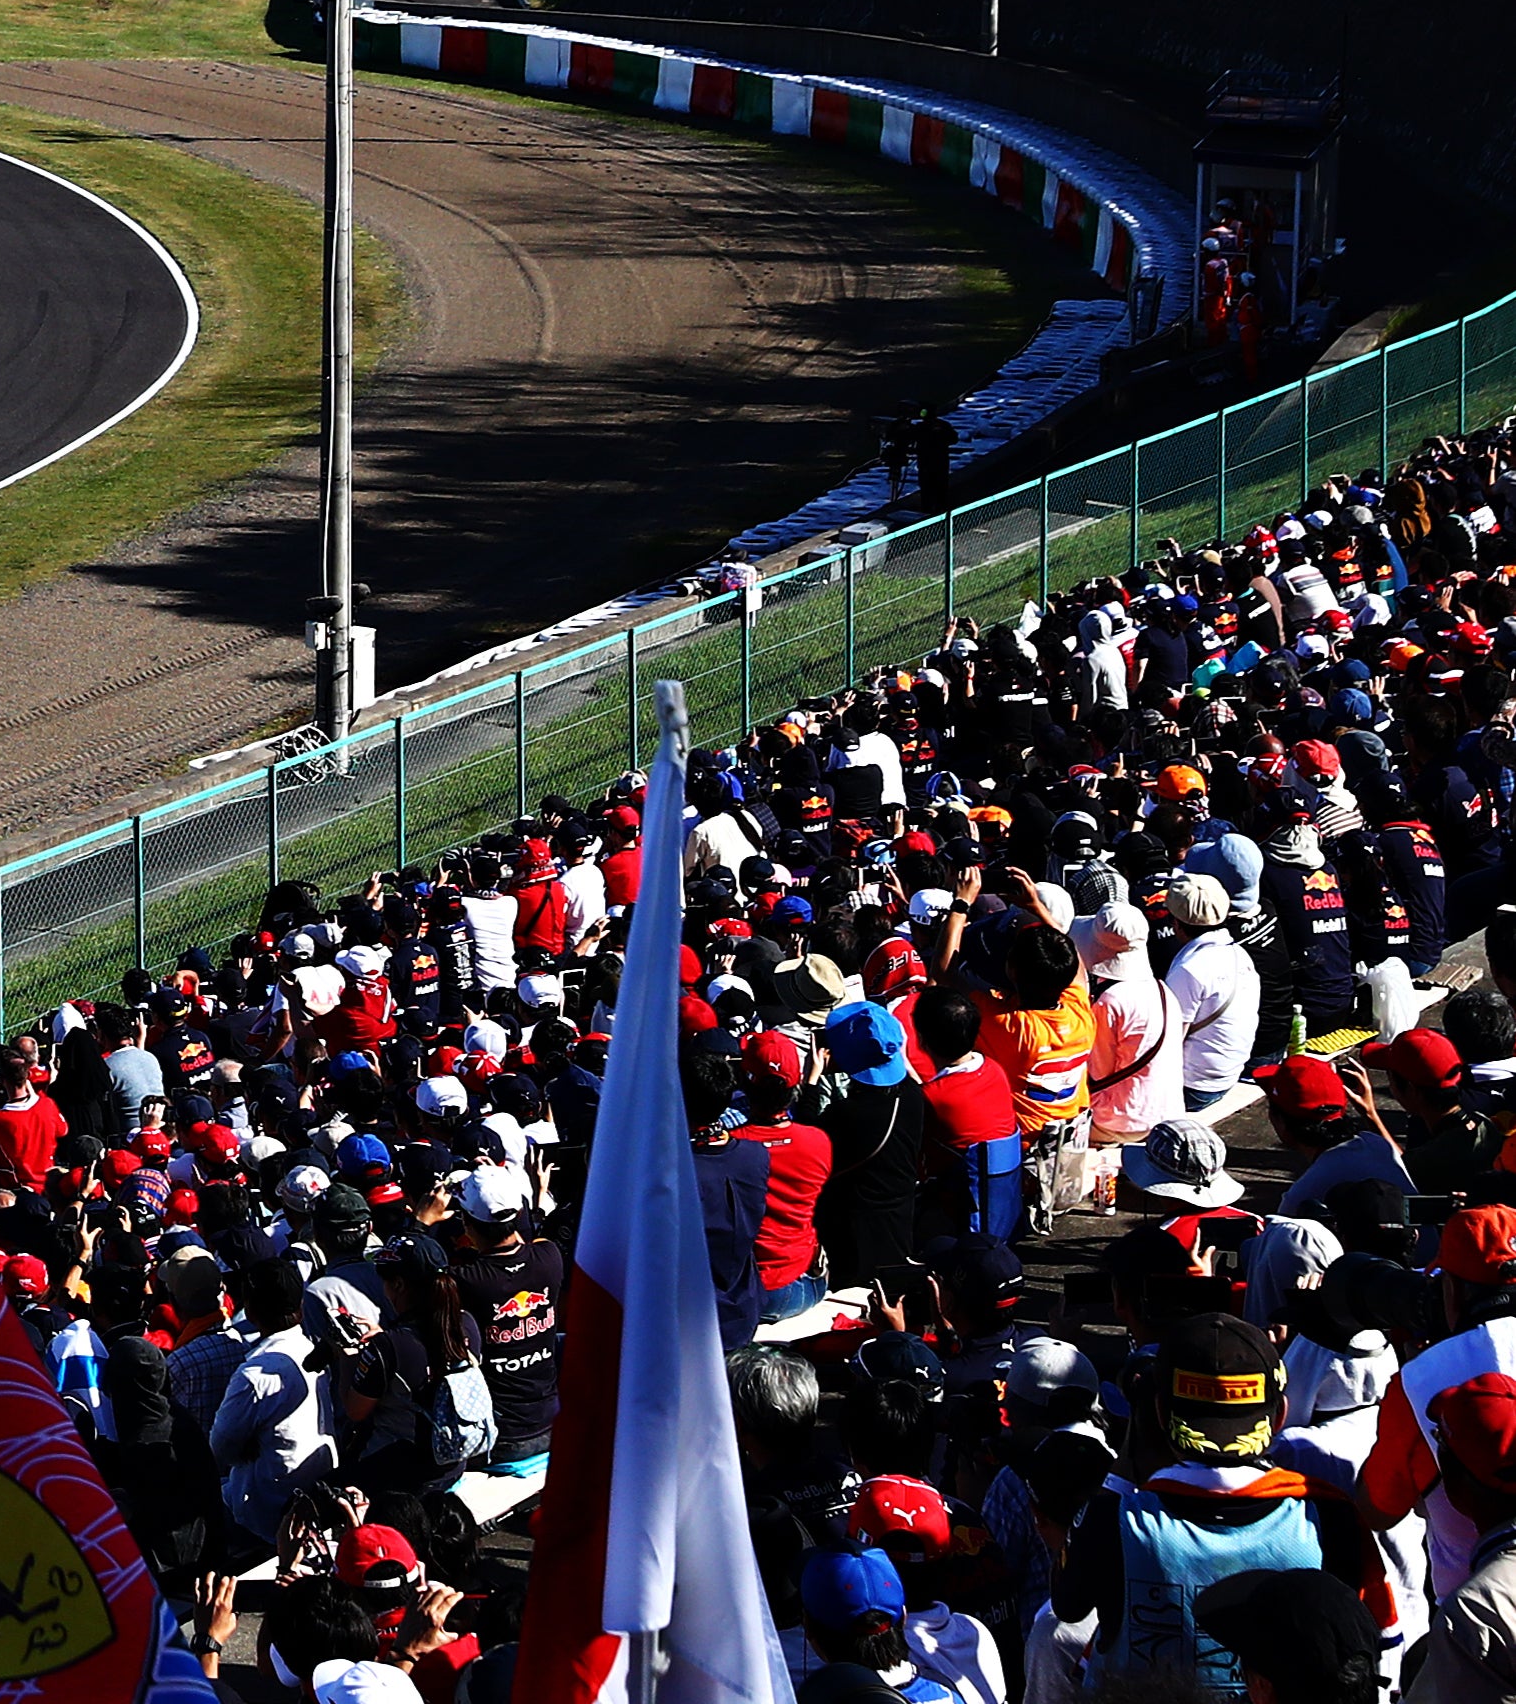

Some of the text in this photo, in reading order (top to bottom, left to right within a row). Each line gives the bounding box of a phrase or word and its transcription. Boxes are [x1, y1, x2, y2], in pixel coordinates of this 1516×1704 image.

[1303, 895, 1329, 910] Red
[1312, 918, 1340, 933] Mobil
[180, 1051, 215, 1072] Red Bull
[486, 1306, 555, 1344] Red Bull
[490, 1348, 552, 1373] TOTAL
